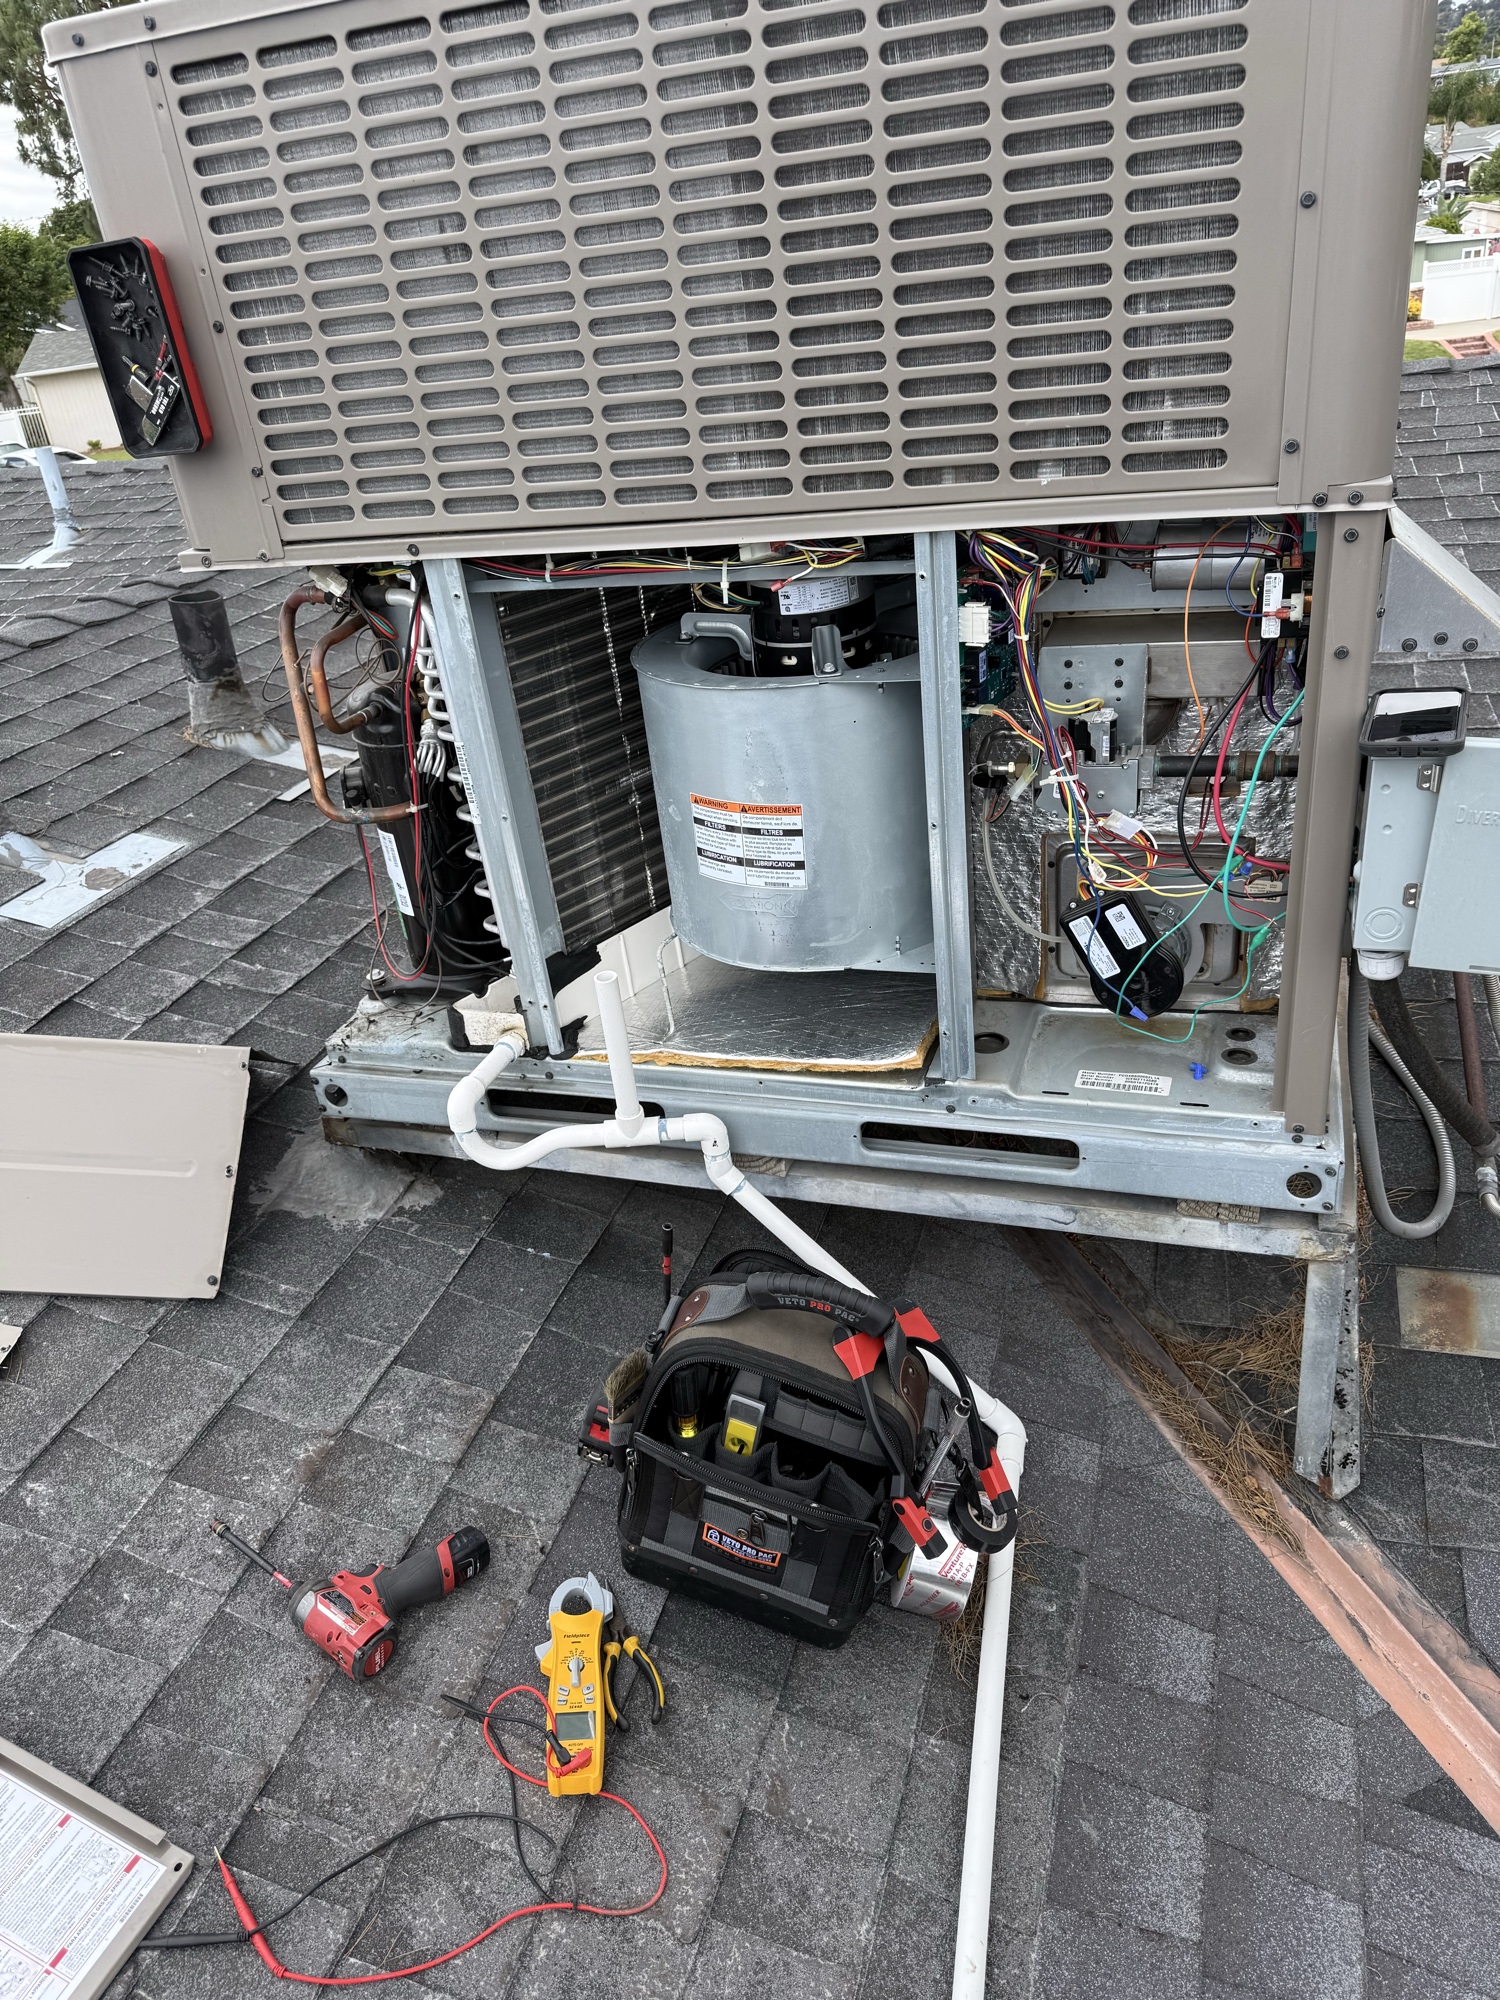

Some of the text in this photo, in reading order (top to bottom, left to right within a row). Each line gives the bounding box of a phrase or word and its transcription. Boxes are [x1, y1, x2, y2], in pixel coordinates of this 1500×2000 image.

[699, 798, 728, 809] WARNING
[748, 806, 800, 814] AVERTISSEMENT
[704, 820, 726, 830] FILTERS
[702, 850, 737, 863] LUBRICATION
[778, 1297, 806, 1306] VETO
[810, 1301, 831, 1312] PRO
[722, 1535, 740, 1549] VETO
[742, 1545, 756, 1555] PRO
[948, 1561, 965, 1583] 181A-P
[955, 1562, 974, 1588] 181B-FX
[28, 1858, 34, 1866] DE
[66, 1935, 77, 1948] PARA
[96, 1901, 105, 1911] GAS
